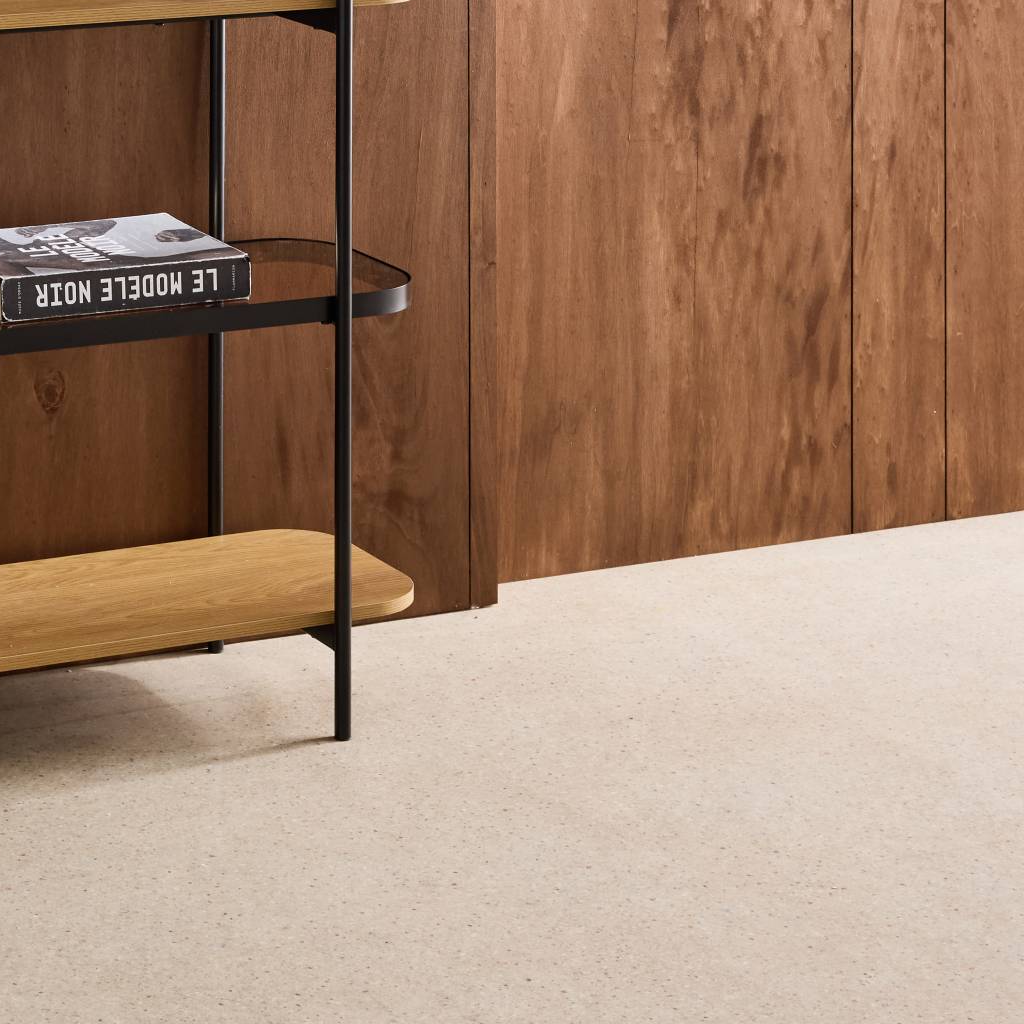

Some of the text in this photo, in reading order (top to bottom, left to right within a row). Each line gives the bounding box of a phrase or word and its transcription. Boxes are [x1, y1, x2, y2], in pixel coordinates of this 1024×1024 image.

[17, 245, 59, 257] LE
[191, 268, 218, 293] LE
[35, 279, 92, 308] NOIR
